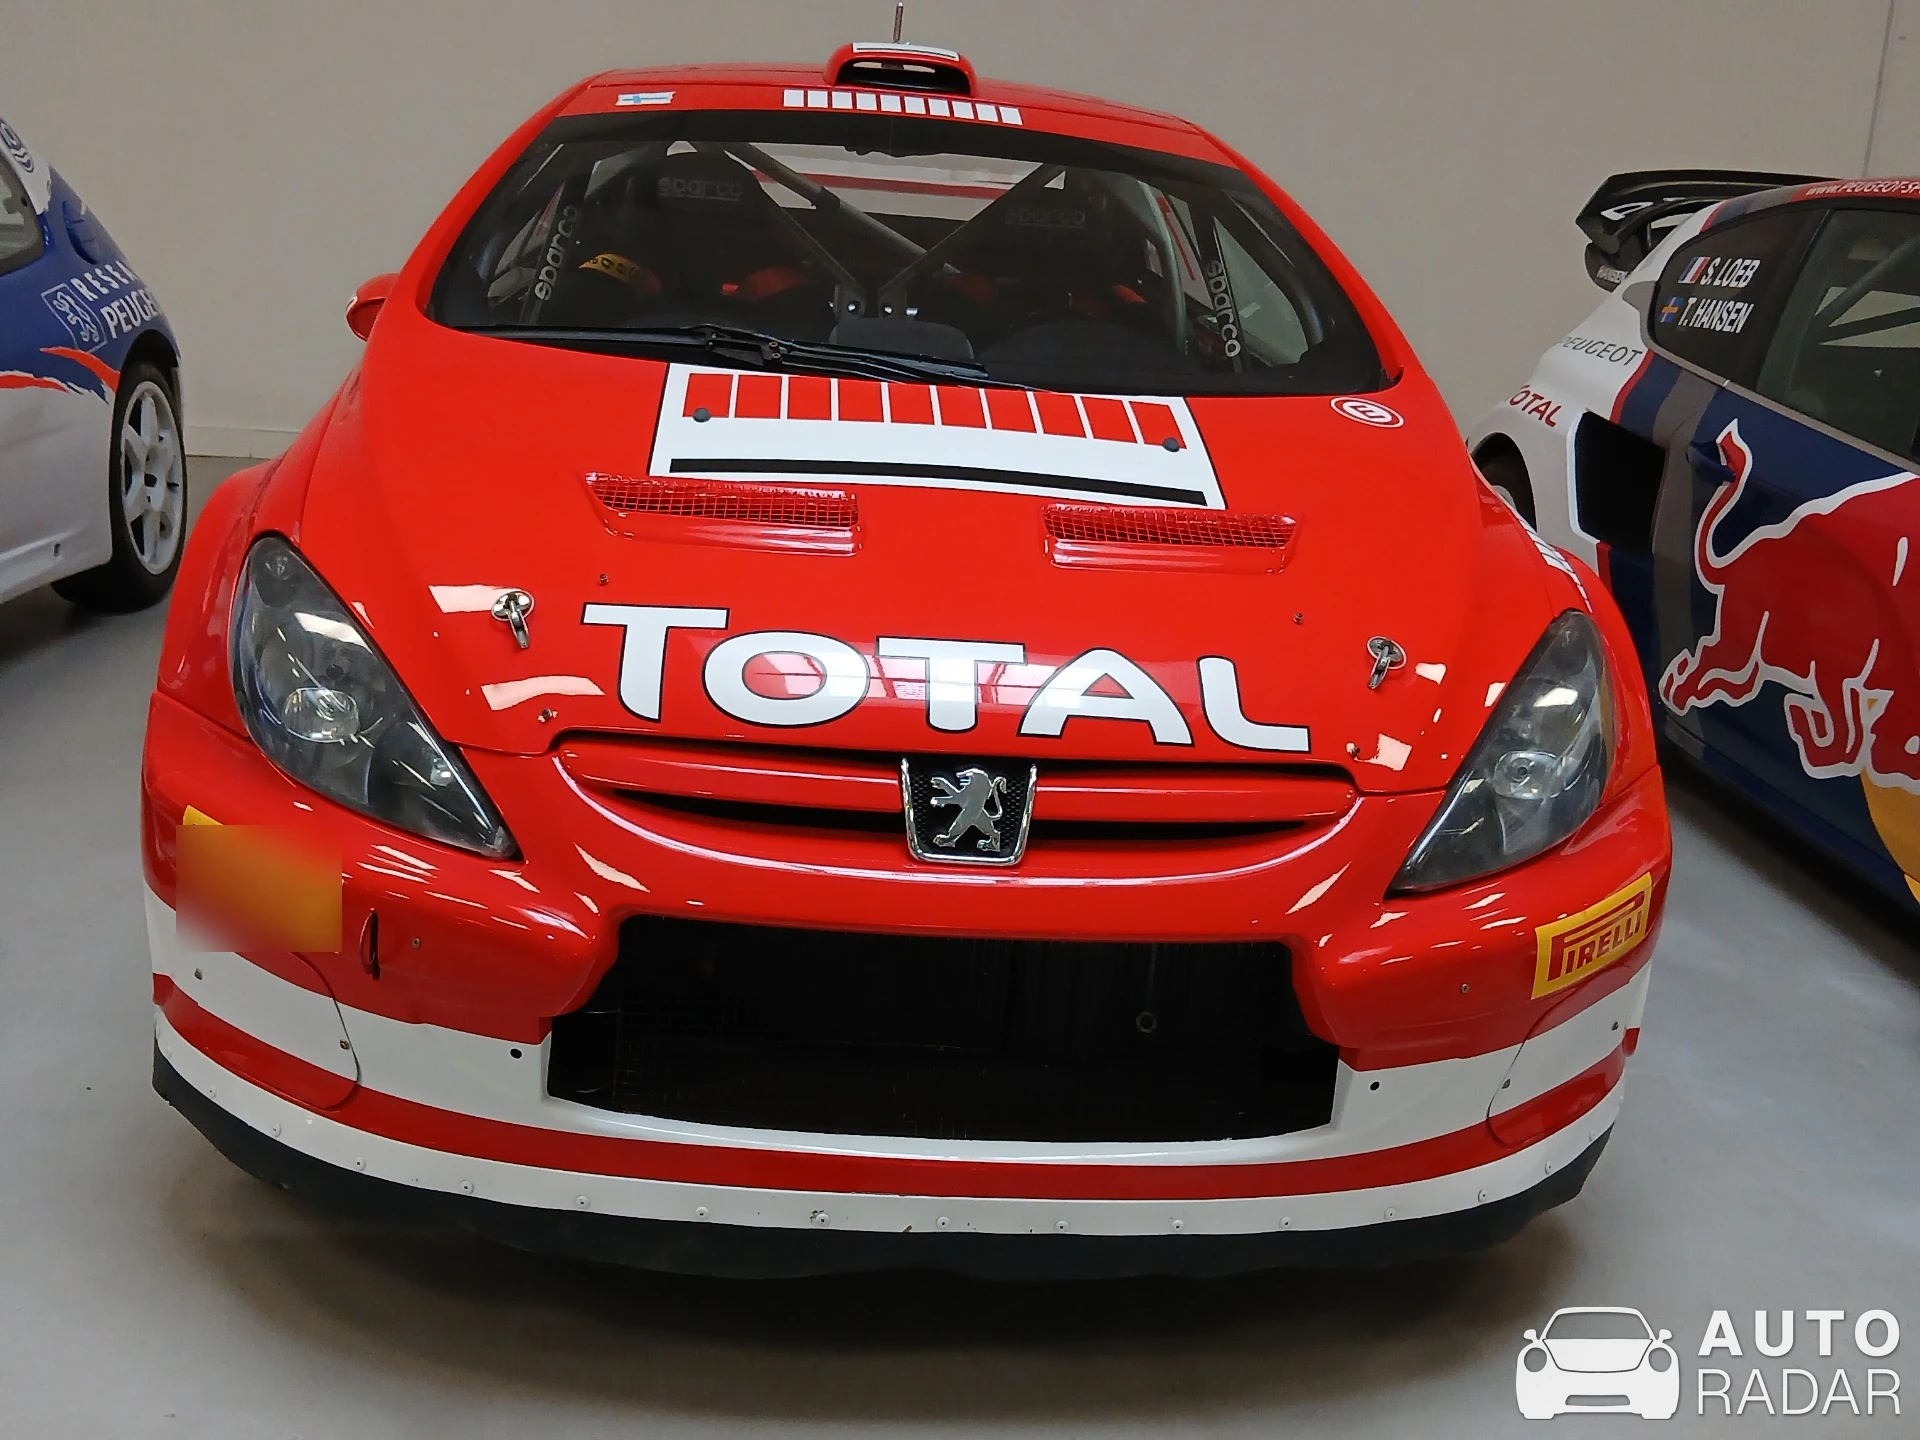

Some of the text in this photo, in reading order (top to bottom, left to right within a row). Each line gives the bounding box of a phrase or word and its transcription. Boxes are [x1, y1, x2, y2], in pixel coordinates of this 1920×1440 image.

[535, 205, 578, 301] sparco
[100, 289, 162, 339] PEUGE
[1207, 260, 1241, 357] sparco
[581, 602, 1311, 753] TOTAL
[1547, 890, 1646, 982] PIRELLI
